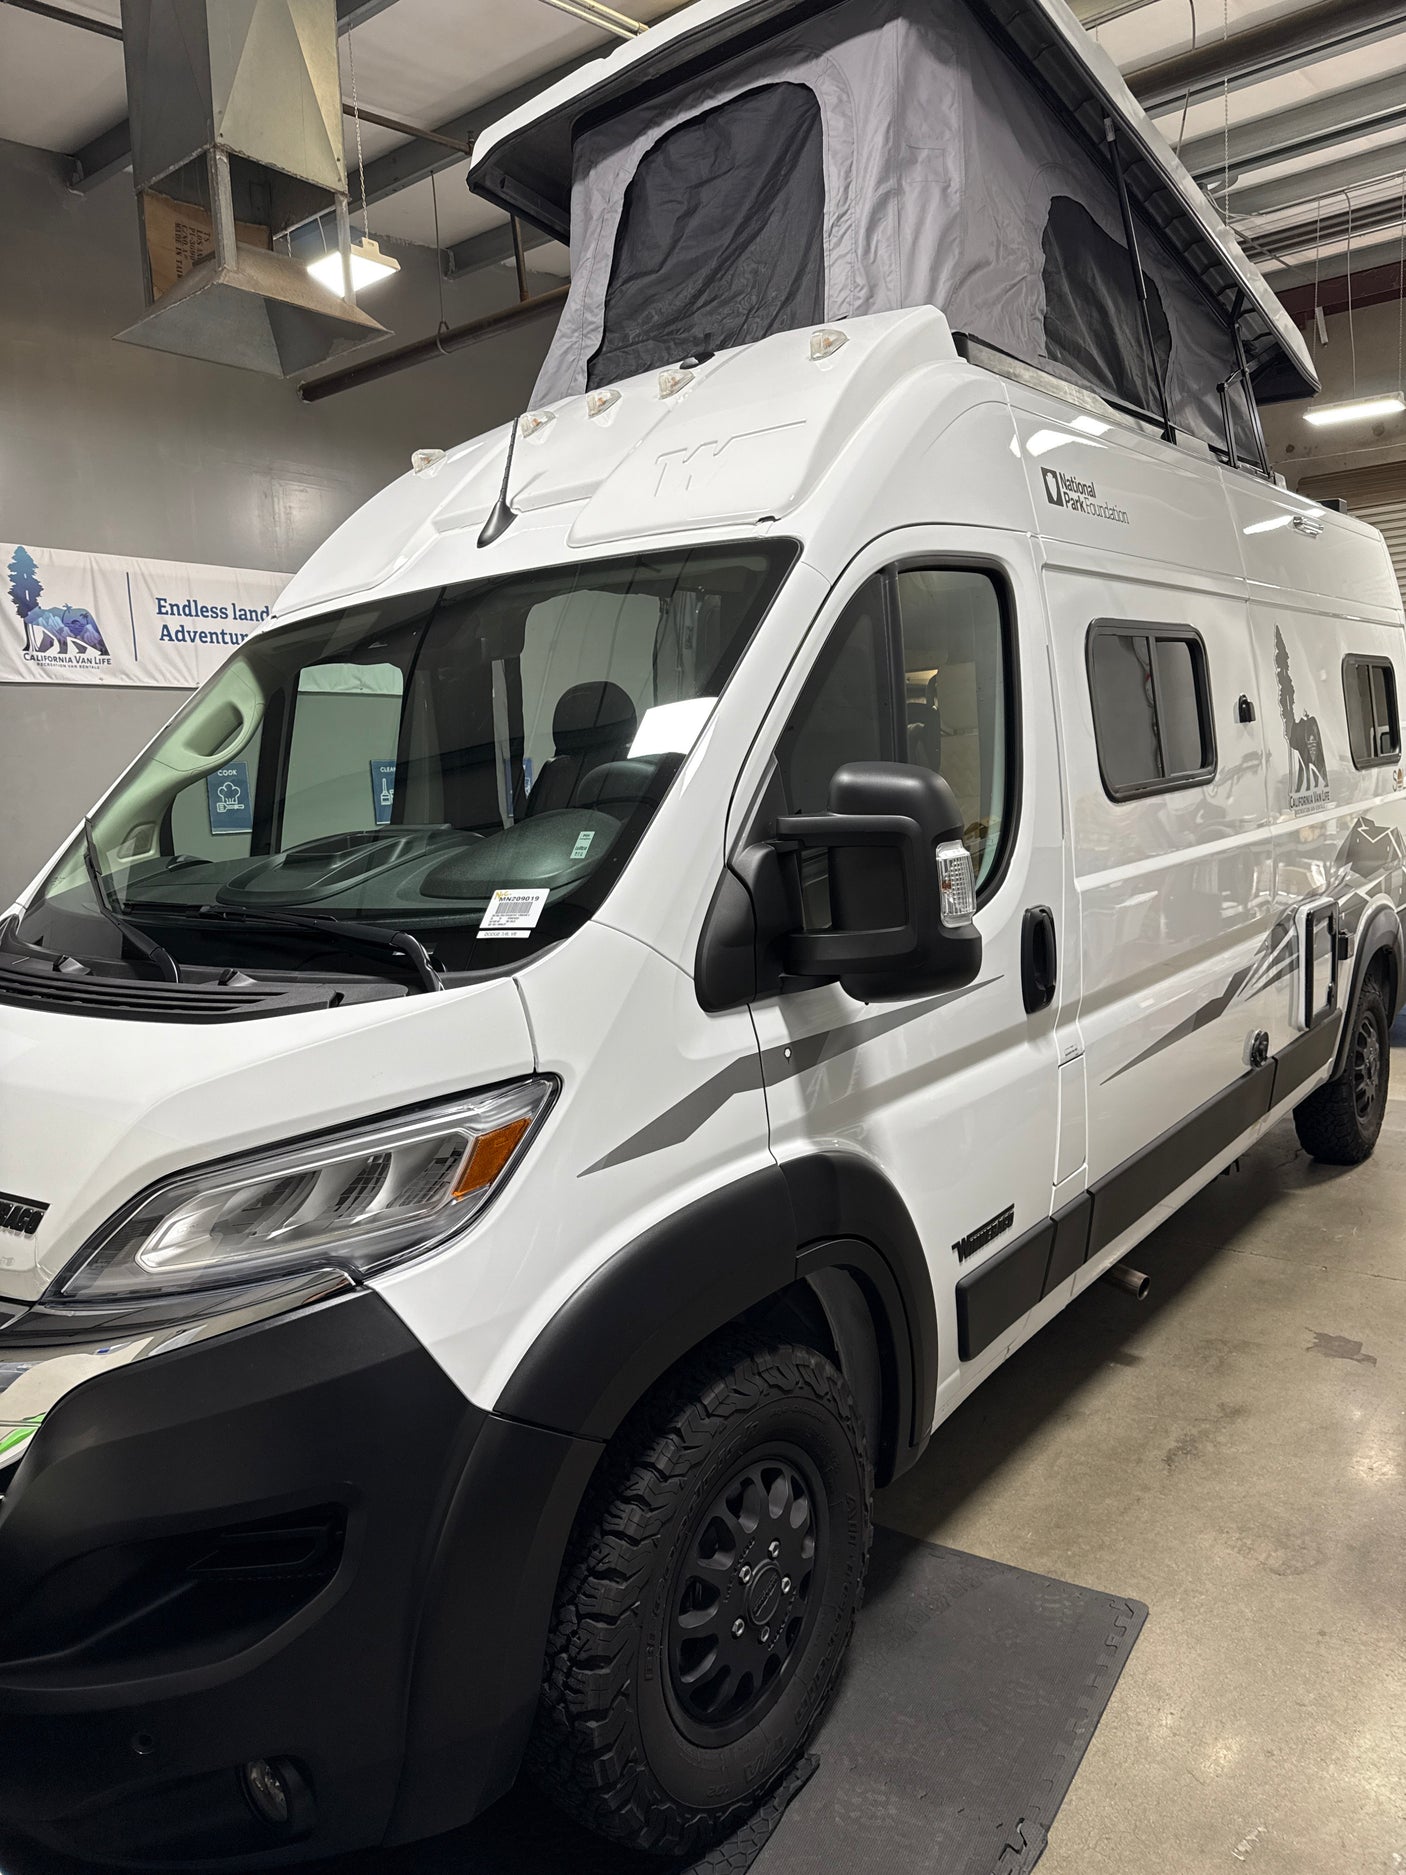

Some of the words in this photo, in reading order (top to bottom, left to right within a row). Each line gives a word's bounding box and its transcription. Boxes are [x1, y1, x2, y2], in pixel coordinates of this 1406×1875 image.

[1058, 471, 1097, 498] National
[1063, 490, 1087, 514] Park
[1083, 496, 1130, 525] Foundation
[155, 597, 229, 620] Endless
[23, 652, 74, 664] CALIFORNIA
[74, 655, 93, 665] VAN
[94, 656, 112, 665] LIFE
[217, 769, 238, 777] COOK
